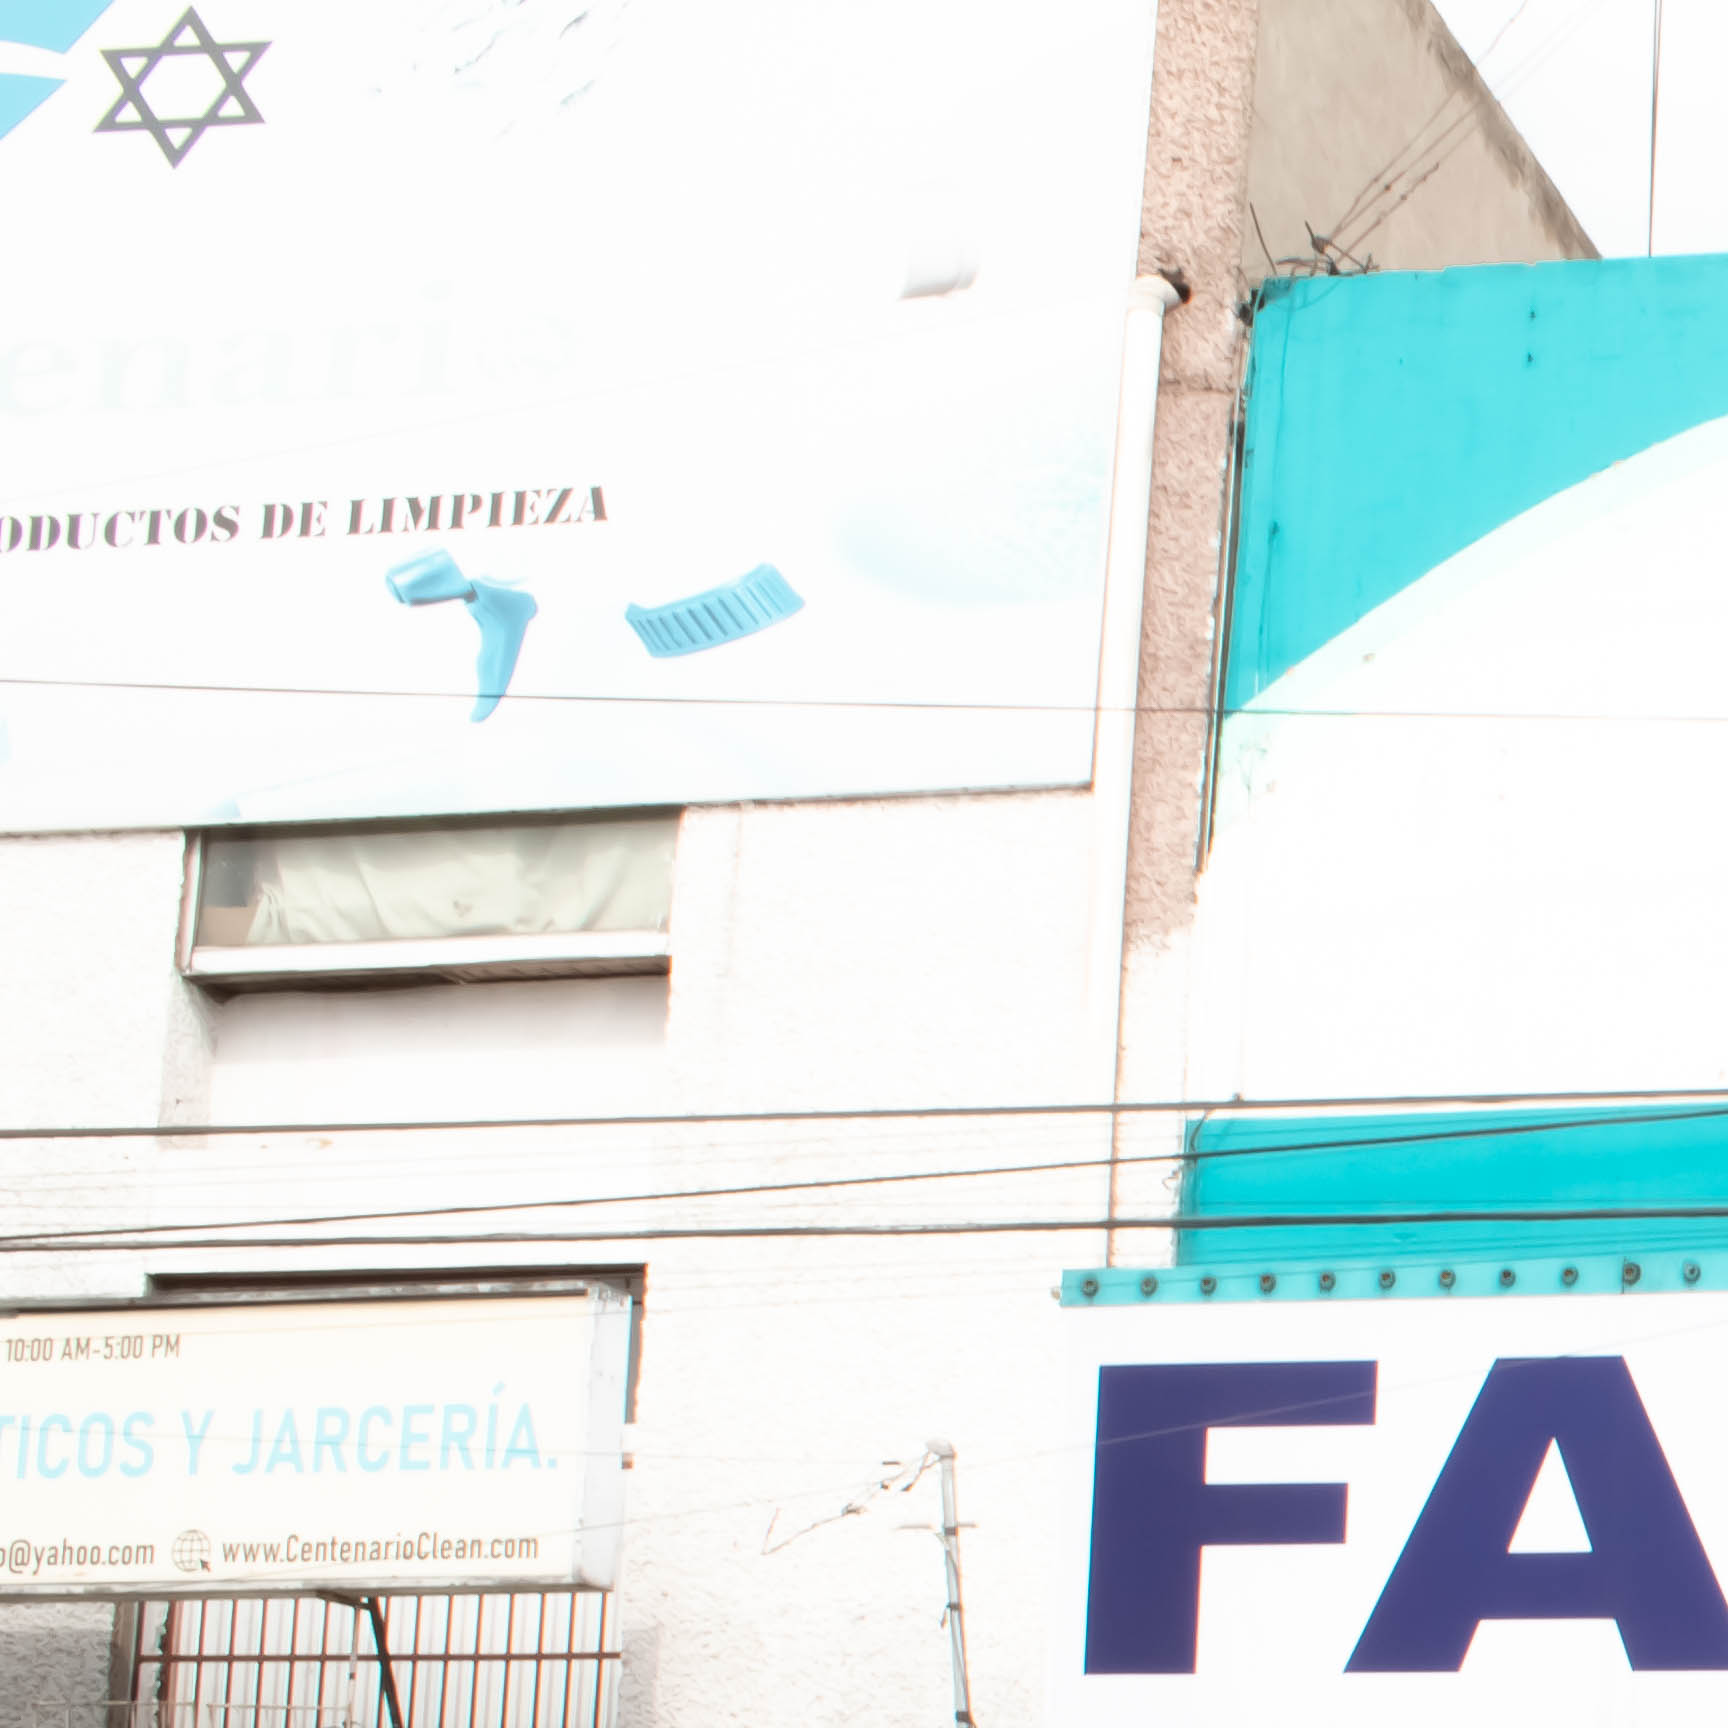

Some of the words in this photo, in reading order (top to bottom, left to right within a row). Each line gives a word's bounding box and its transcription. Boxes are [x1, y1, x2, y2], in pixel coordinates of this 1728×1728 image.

[257, 500, 329, 541] DE
[344, 483, 610, 537] LIMPIEZA
[4, 1336, 54, 1363] 10:00
[60, 1334, 144, 1361] AM-5:00
[151, 1332, 182, 1360] PM
[178, 1408, 216, 1477] Y
[232, 1379, 558, 1475] JARCERÍA.
[221, 1530, 540, 1566] www.CentenarioClean.com
